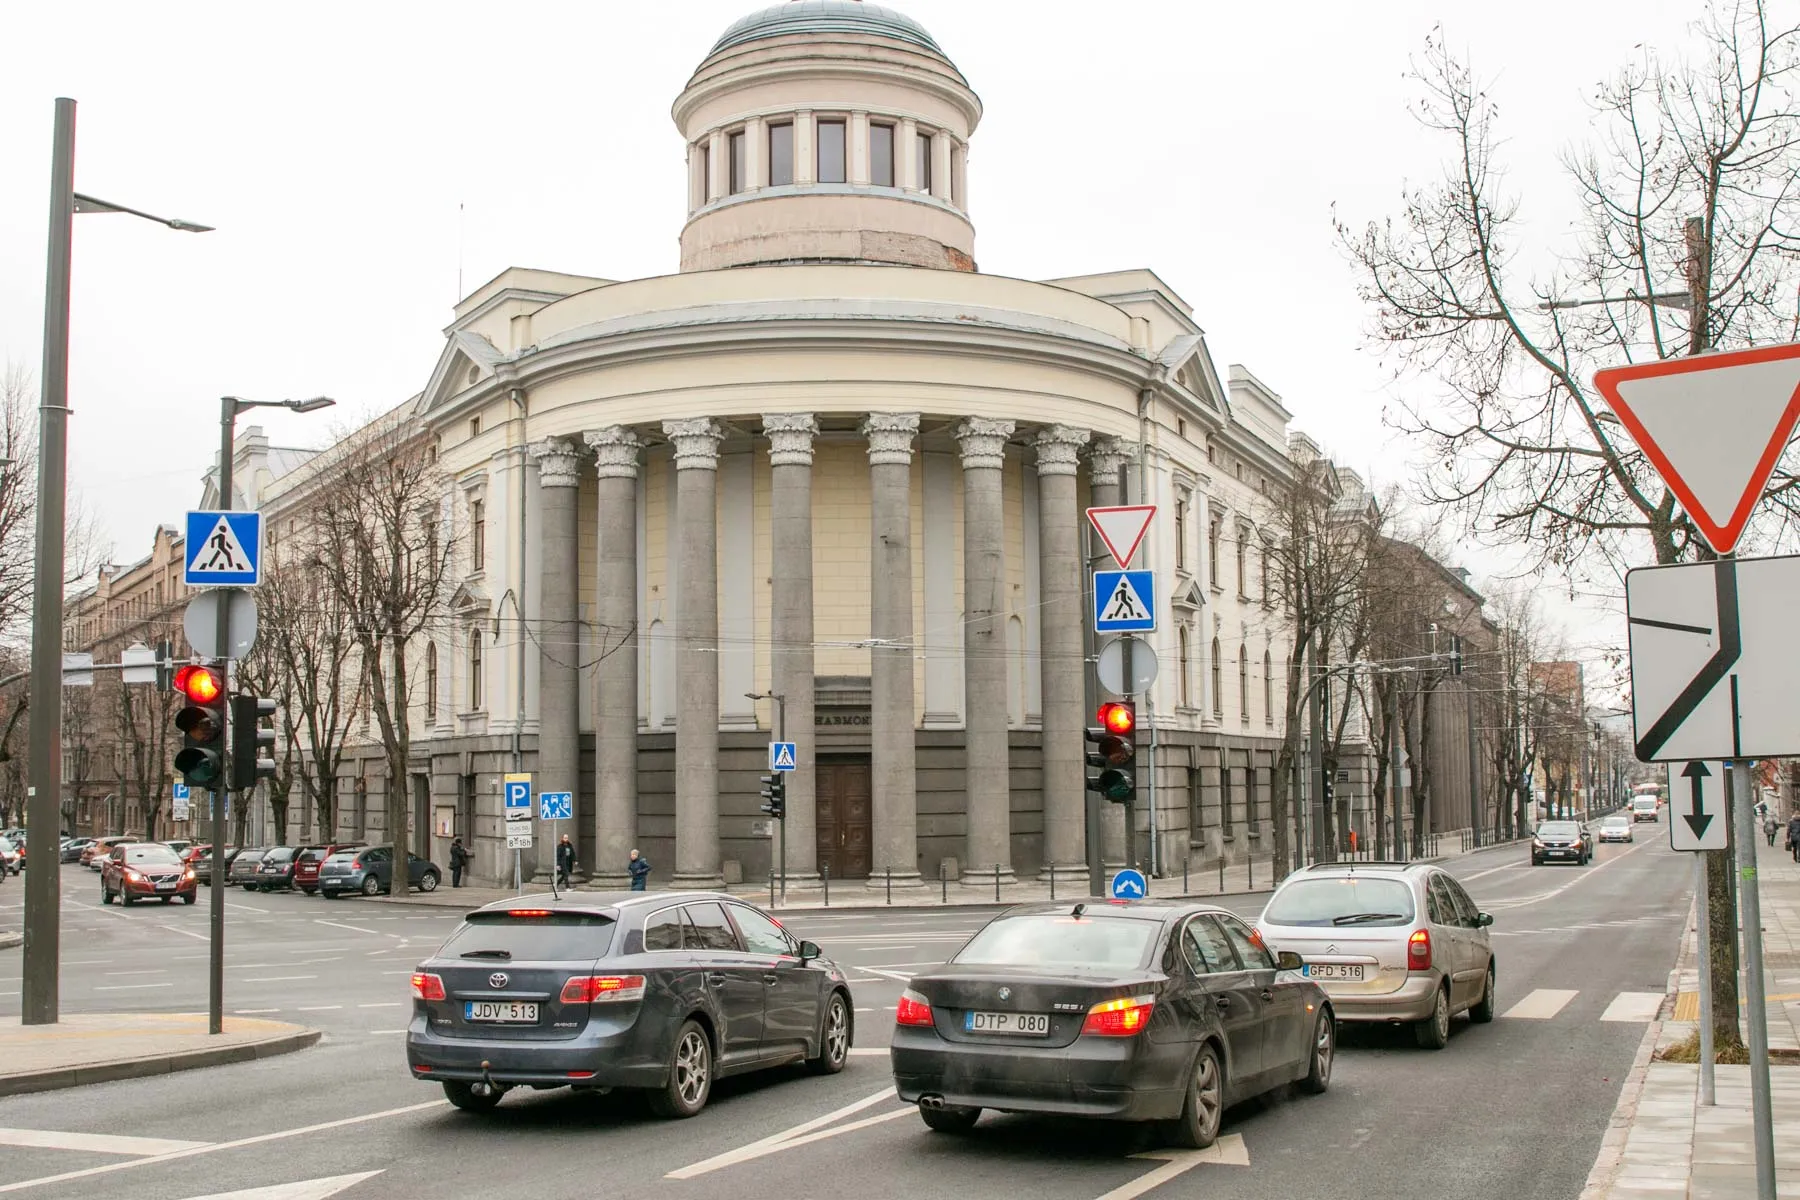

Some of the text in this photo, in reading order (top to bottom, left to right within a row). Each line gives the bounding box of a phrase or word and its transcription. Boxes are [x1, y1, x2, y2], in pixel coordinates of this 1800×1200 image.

[178, 785, 187, 796] P
[512, 785, 526, 805] P
[1310, 965, 1361, 976] GFD 516
[474, 1004, 501, 1018] JDV
[511, 1005, 536, 1019] 513
[975, 1014, 1008, 1029] DTP
[1018, 1016, 1046, 1031] 080
